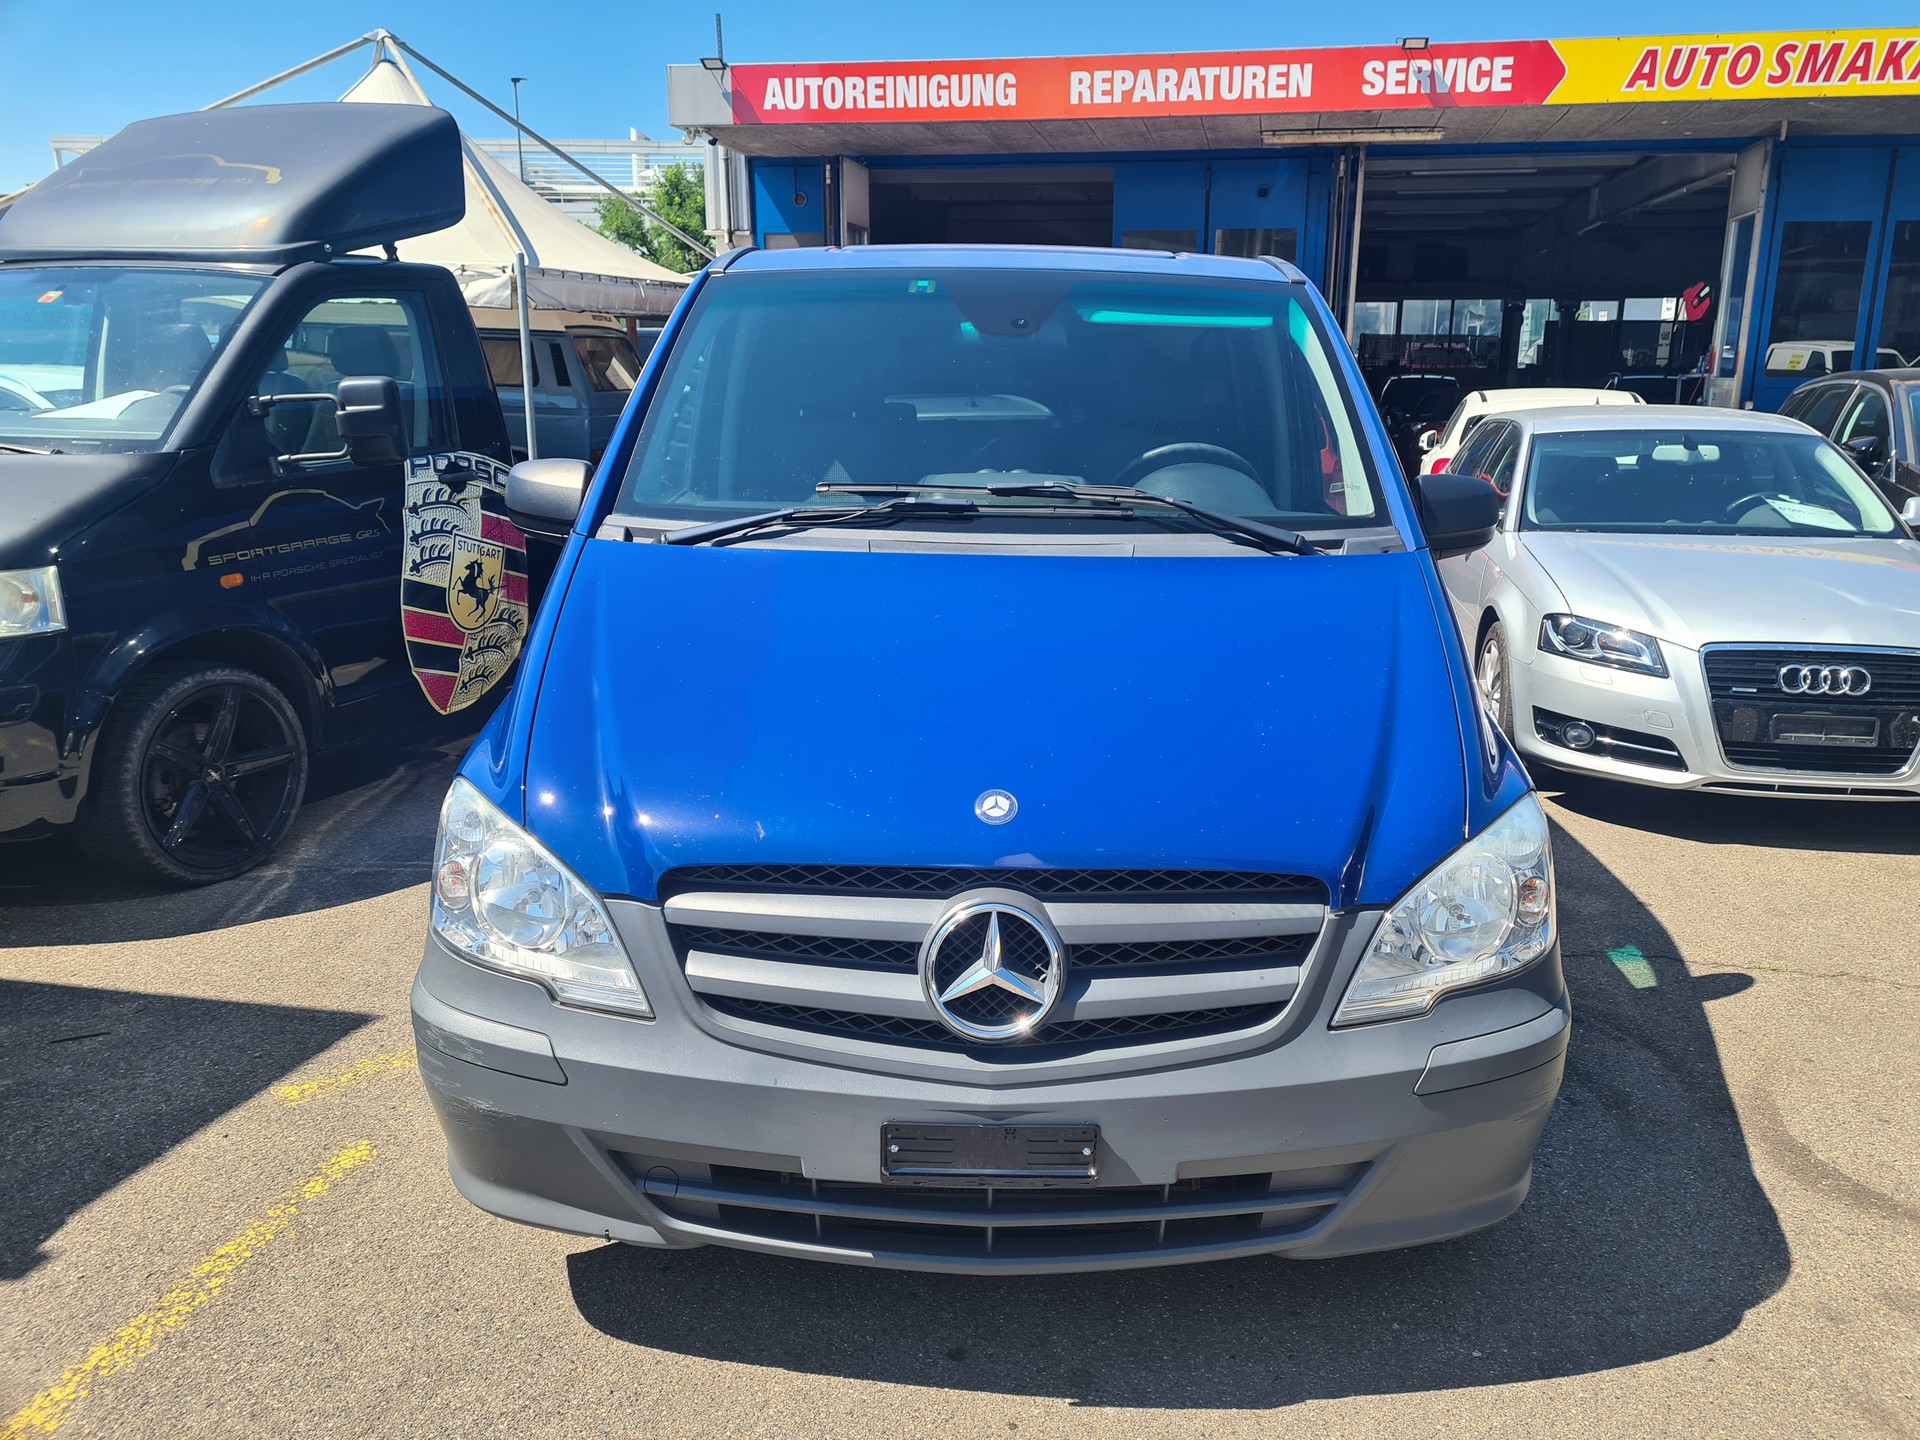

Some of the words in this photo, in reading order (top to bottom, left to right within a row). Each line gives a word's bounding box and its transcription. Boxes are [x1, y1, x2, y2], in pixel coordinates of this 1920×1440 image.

[1070, 64, 1312, 103] REPARATUREN
[1362, 57, 1513, 95] SERVICE
[1622, 44, 1761, 91] AUTO
[763, 73, 1016, 110] AUTOREINIGUNG
[207, 533, 352, 566] SPORTGARAGE
[250, 572, 271, 583] IHR
[272, 561, 327, 579] PORSCHE
[328, 550, 385, 569] SPEZIALIST
[456, 539, 502, 561] STUTTGART
